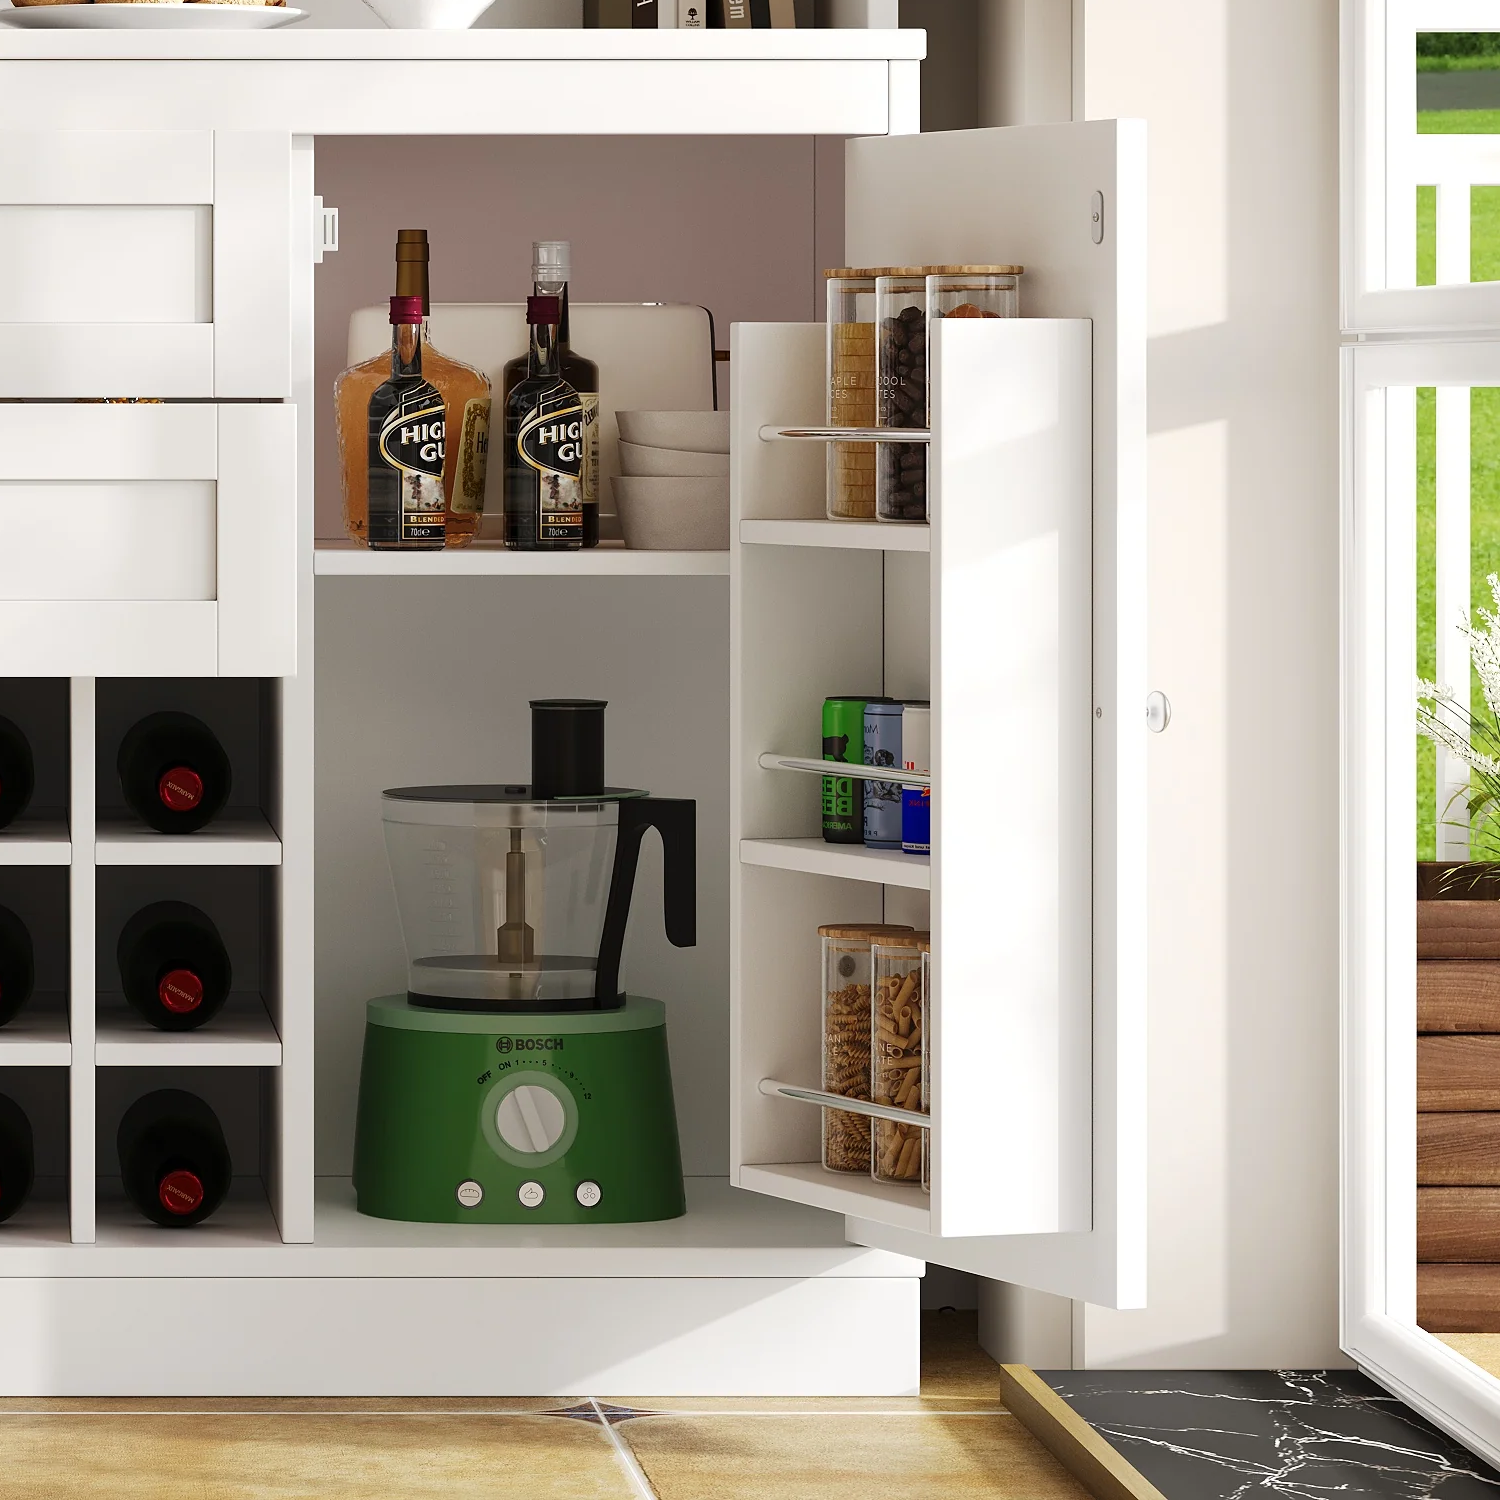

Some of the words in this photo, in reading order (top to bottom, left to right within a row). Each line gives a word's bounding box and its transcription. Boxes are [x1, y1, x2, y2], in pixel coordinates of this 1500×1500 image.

[167, 781, 194, 800] MARGAUX
[167, 984, 194, 1002] MARGAUX
[515, 1038, 564, 1051] BOSCH
[476, 1070, 492, 1085] OFF
[498, 1060, 512, 1071] ON
[167, 1184, 194, 1204] MARGAUX
